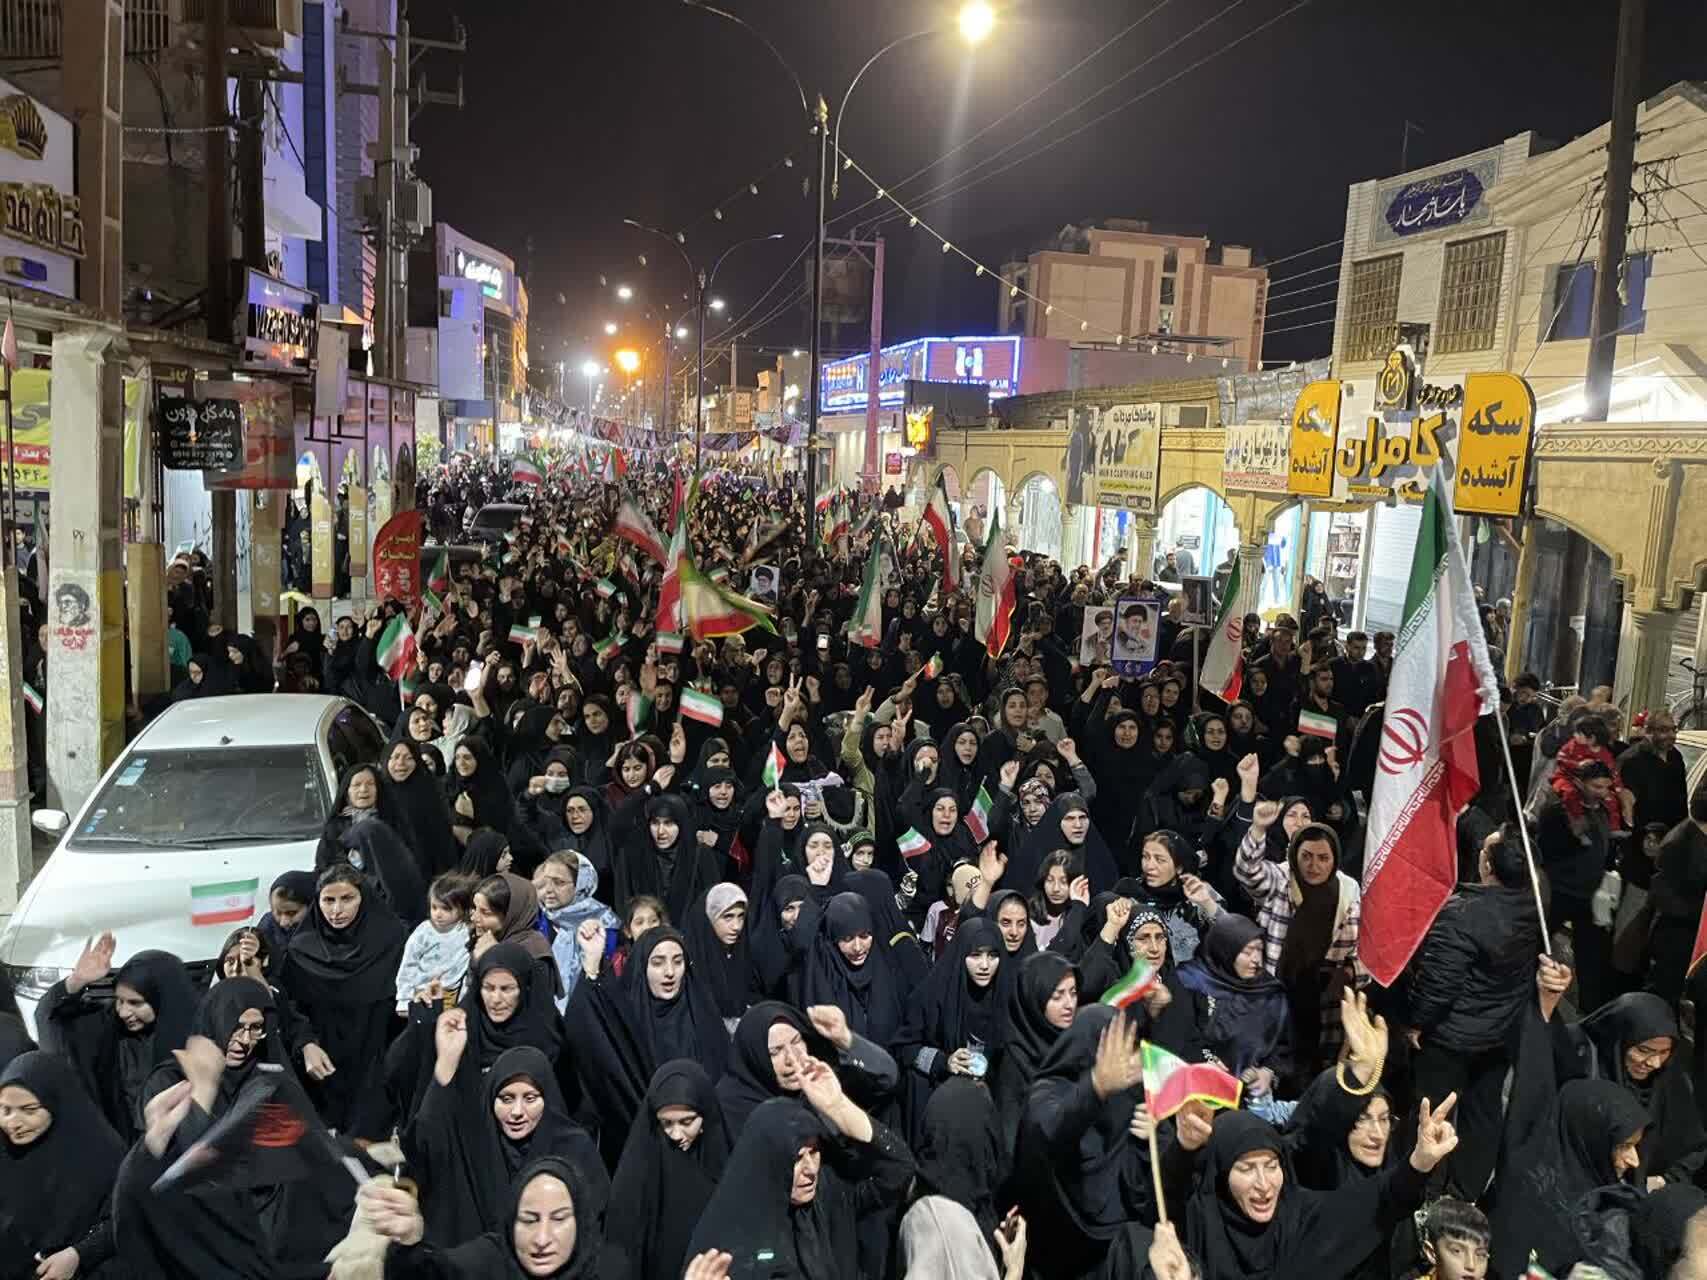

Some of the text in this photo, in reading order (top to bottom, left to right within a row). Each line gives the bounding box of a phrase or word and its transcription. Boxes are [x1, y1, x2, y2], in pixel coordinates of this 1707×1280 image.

[1467, 401, 1523, 436] سکه
[1292, 447, 1330, 481] آبشده
[1336, 413, 1446, 479] کامران
[1460, 456, 1520, 497] آبشده
